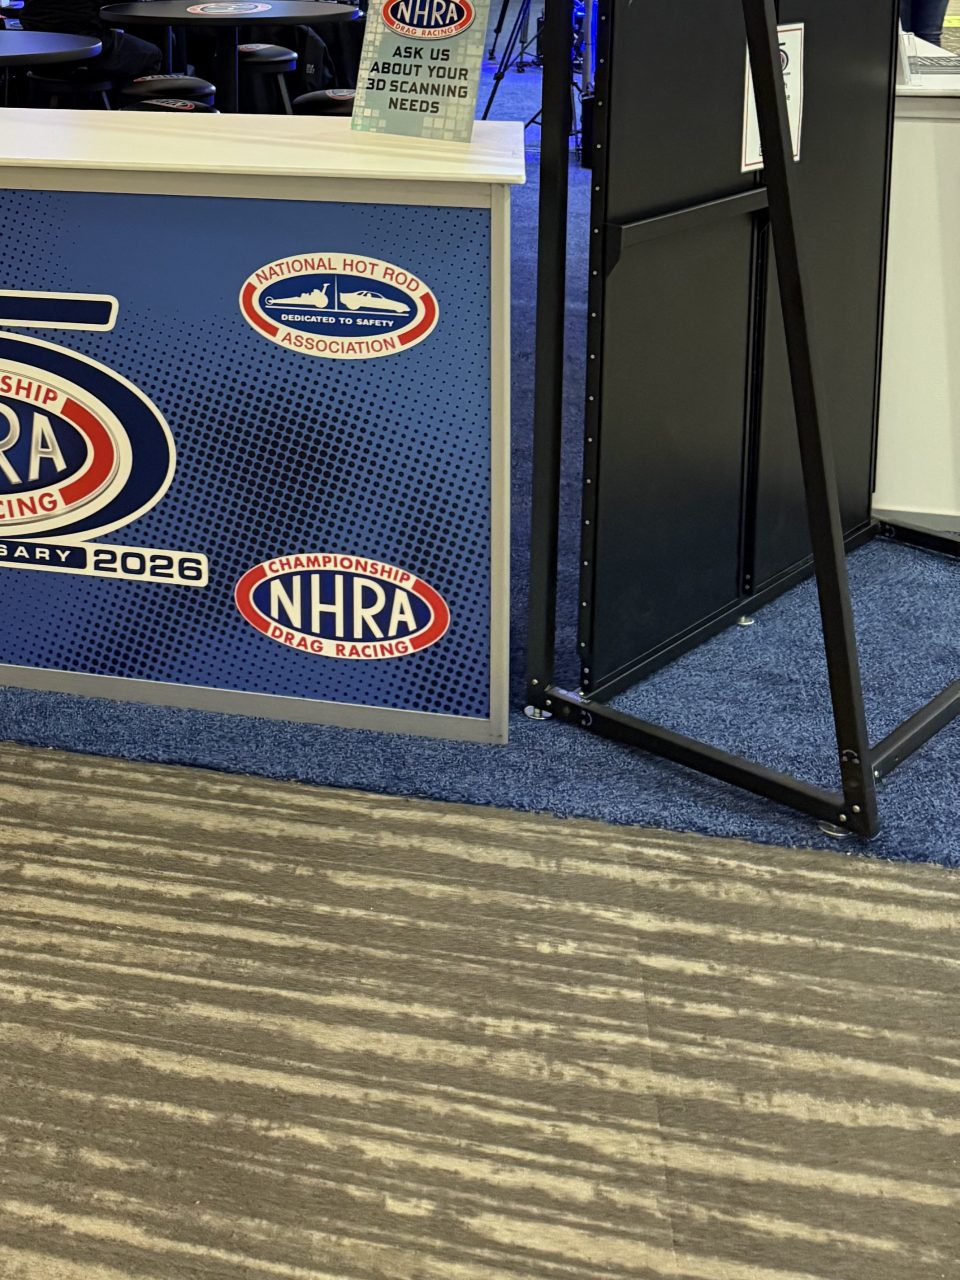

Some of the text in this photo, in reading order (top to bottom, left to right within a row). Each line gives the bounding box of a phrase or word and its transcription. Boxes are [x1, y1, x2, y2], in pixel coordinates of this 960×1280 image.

[394, 22, 454, 37] DRAG RACING
[392, 45, 450, 61] ASK US
[370, 61, 469, 81] ABOUT YOUR
[366, 78, 468, 98] 3D SCANNING
[388, 97, 440, 114] NEEDS
[255, 257, 420, 292] NATIONAL HOT ROD
[281, 314, 394, 328] DEDICATED TO SAFETY
[281, 332, 396, 354] ASSOCIATION
[93, 549, 204, 583] 2026
[268, 555, 411, 584] CHAMPIONSHIP
[270, 573, 418, 639] NHRA
[271, 625, 409, 658] DRAG RACING
